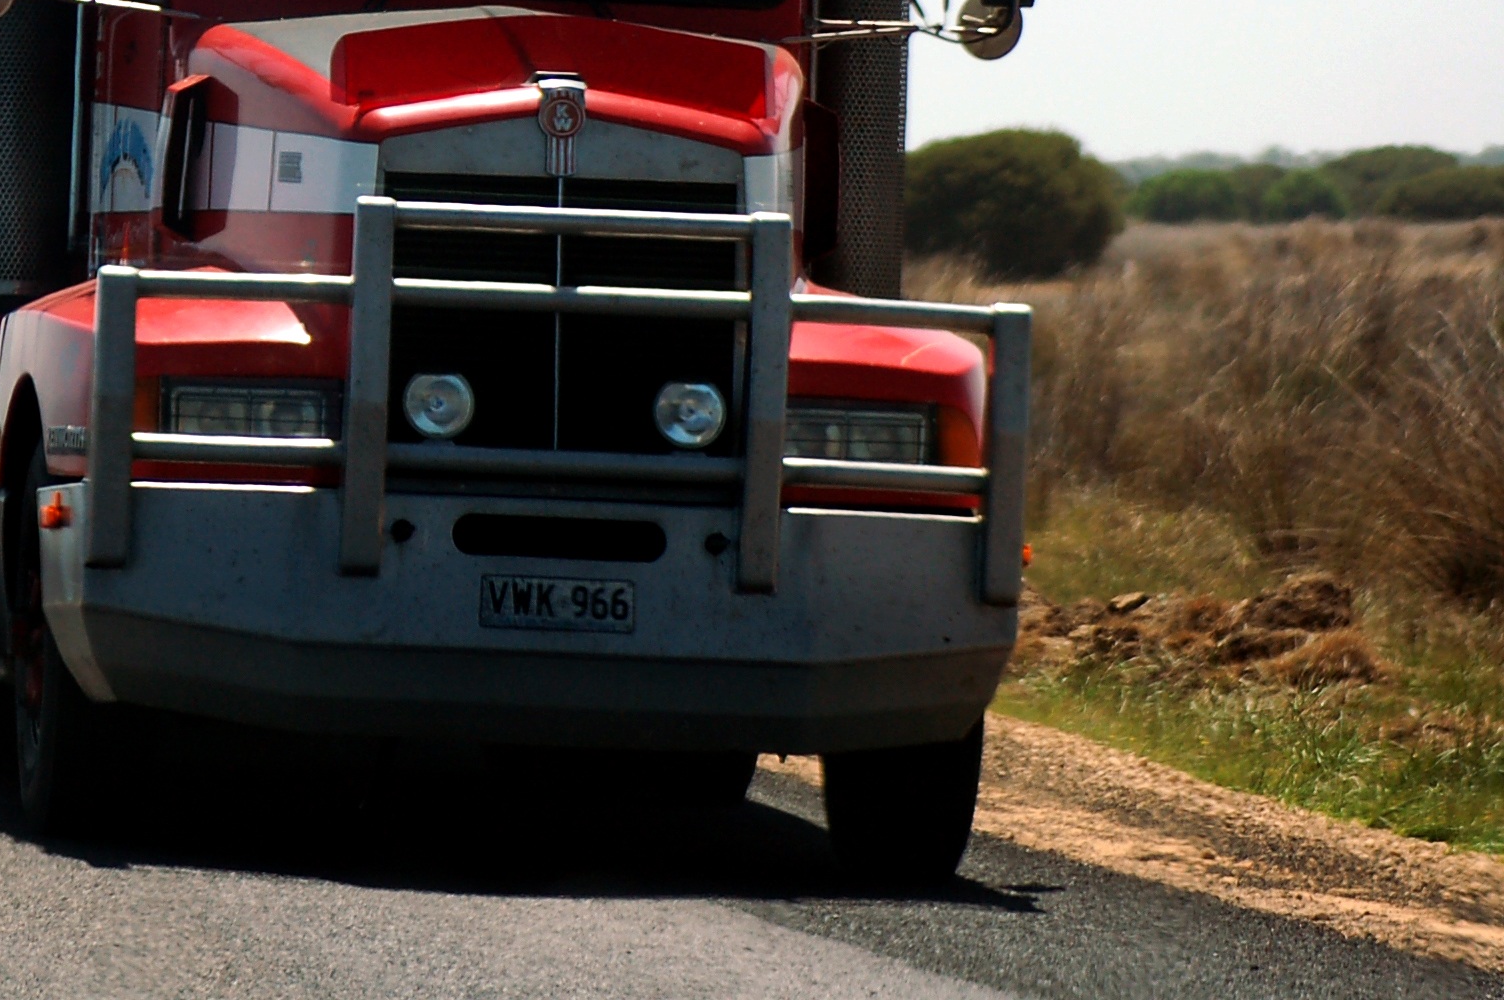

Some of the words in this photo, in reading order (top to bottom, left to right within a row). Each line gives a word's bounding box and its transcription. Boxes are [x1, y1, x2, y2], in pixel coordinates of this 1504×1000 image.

[555, 103, 569, 117] K
[554, 118, 573, 131] W
[489, 579, 556, 617] VWK
[570, 586, 630, 621] 966
